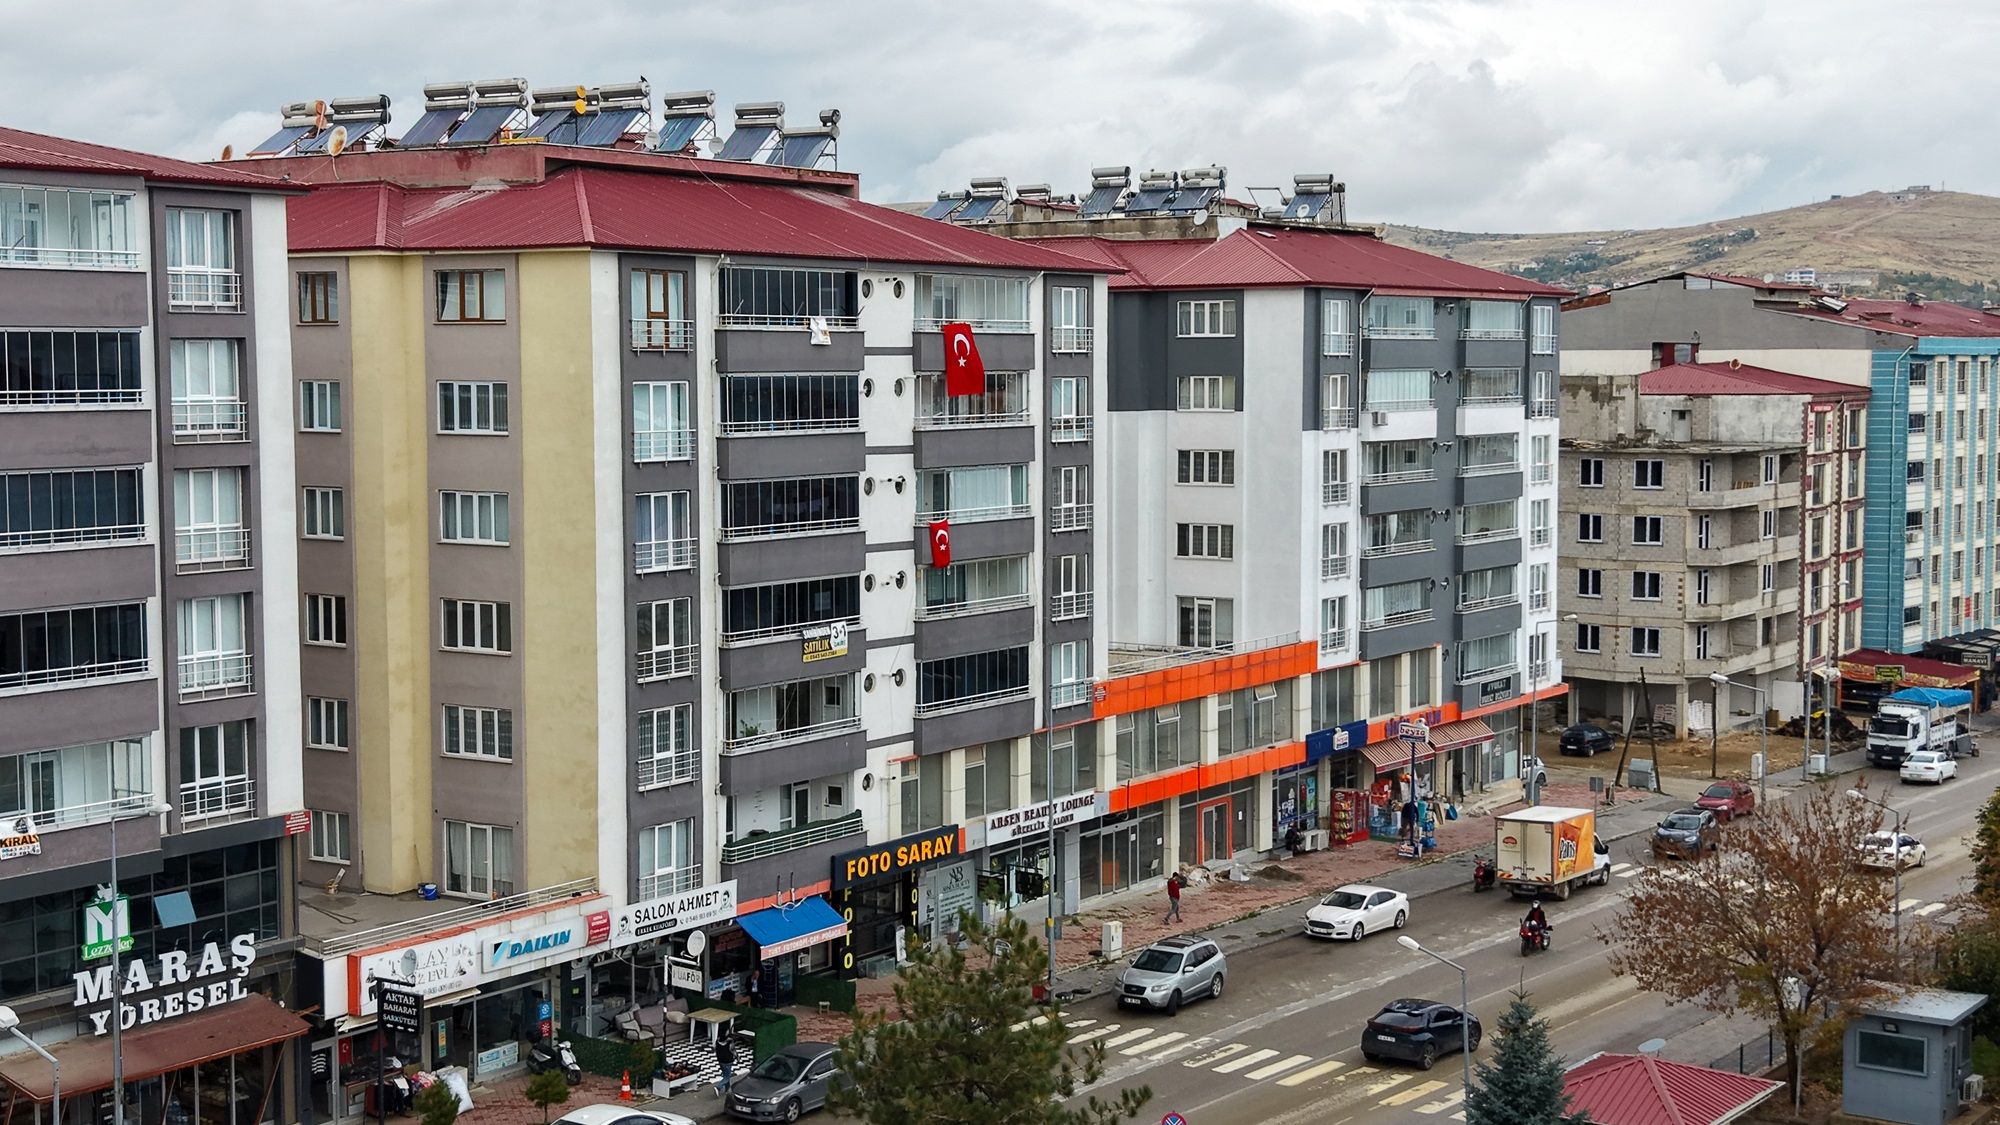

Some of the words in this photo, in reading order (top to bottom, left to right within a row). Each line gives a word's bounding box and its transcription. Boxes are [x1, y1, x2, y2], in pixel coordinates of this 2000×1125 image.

[804, 639, 830, 654] SATILIK
[1024, 803, 1058, 821] BEAUY
[1062, 794, 1095, 812] LOUNGE
[1048, 813, 1074, 829] ALONU
[847, 851, 891, 881] FOTO
[897, 833, 954, 867] SARAY
[634, 902, 675, 924] SALON
[677, 890, 719, 914] AHMET
[844, 887, 853, 969] FOTO
[507, 929, 571, 958] DAIKIN
[73, 933, 256, 1007] MARAŞ
[90, 978, 248, 1036] YÖRESEL
[383, 1003, 417, 1016] BAHARAT
[385, 992, 415, 1006] AKTAR
